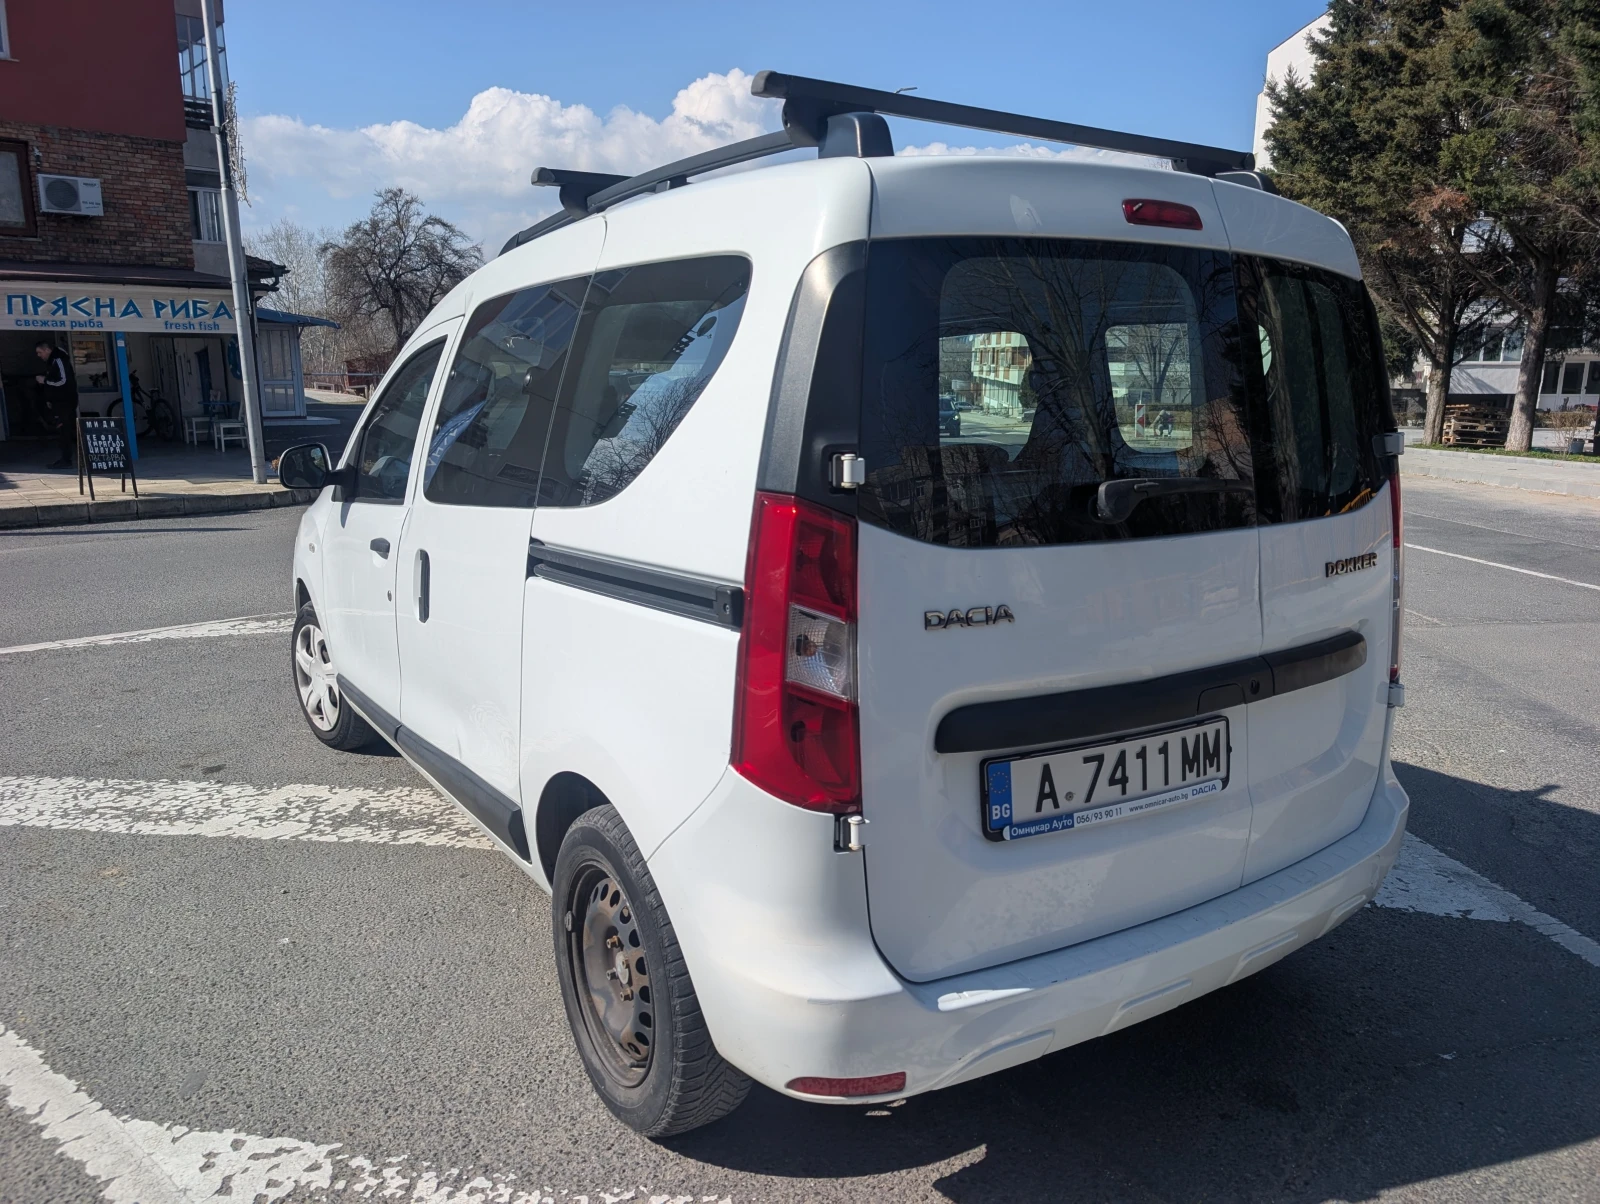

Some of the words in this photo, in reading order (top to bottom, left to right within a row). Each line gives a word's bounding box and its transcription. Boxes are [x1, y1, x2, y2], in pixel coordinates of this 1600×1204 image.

[6, 294, 144, 319] ПРЯСНА
[152, 298, 234, 320] РИБА
[15, 318, 66, 328] свежая
[70, 318, 104, 330] рыба
[164, 320, 196, 331] fresh
[199, 321, 220, 331] fish
[86, 420, 115, 428] МИДИ
[1325, 552, 1378, 578] DOKKER
[924, 603, 1015, 630] DACIA
[1035, 763, 1061, 813] A
[1082, 740, 1170, 804] 7411
[1181, 728, 1222, 783] MM
[1191, 783, 1217, 797] DACIA
[1128, 792, 1189, 813] www.omnicar-auto.bg
[992, 803, 1011, 821] BG
[1076, 811, 1103, 825] 056/93
[1105, 809, 1114, 819] 90
[1115, 807, 1122, 816] 11
[1011, 822, 1051, 837] Омникар
